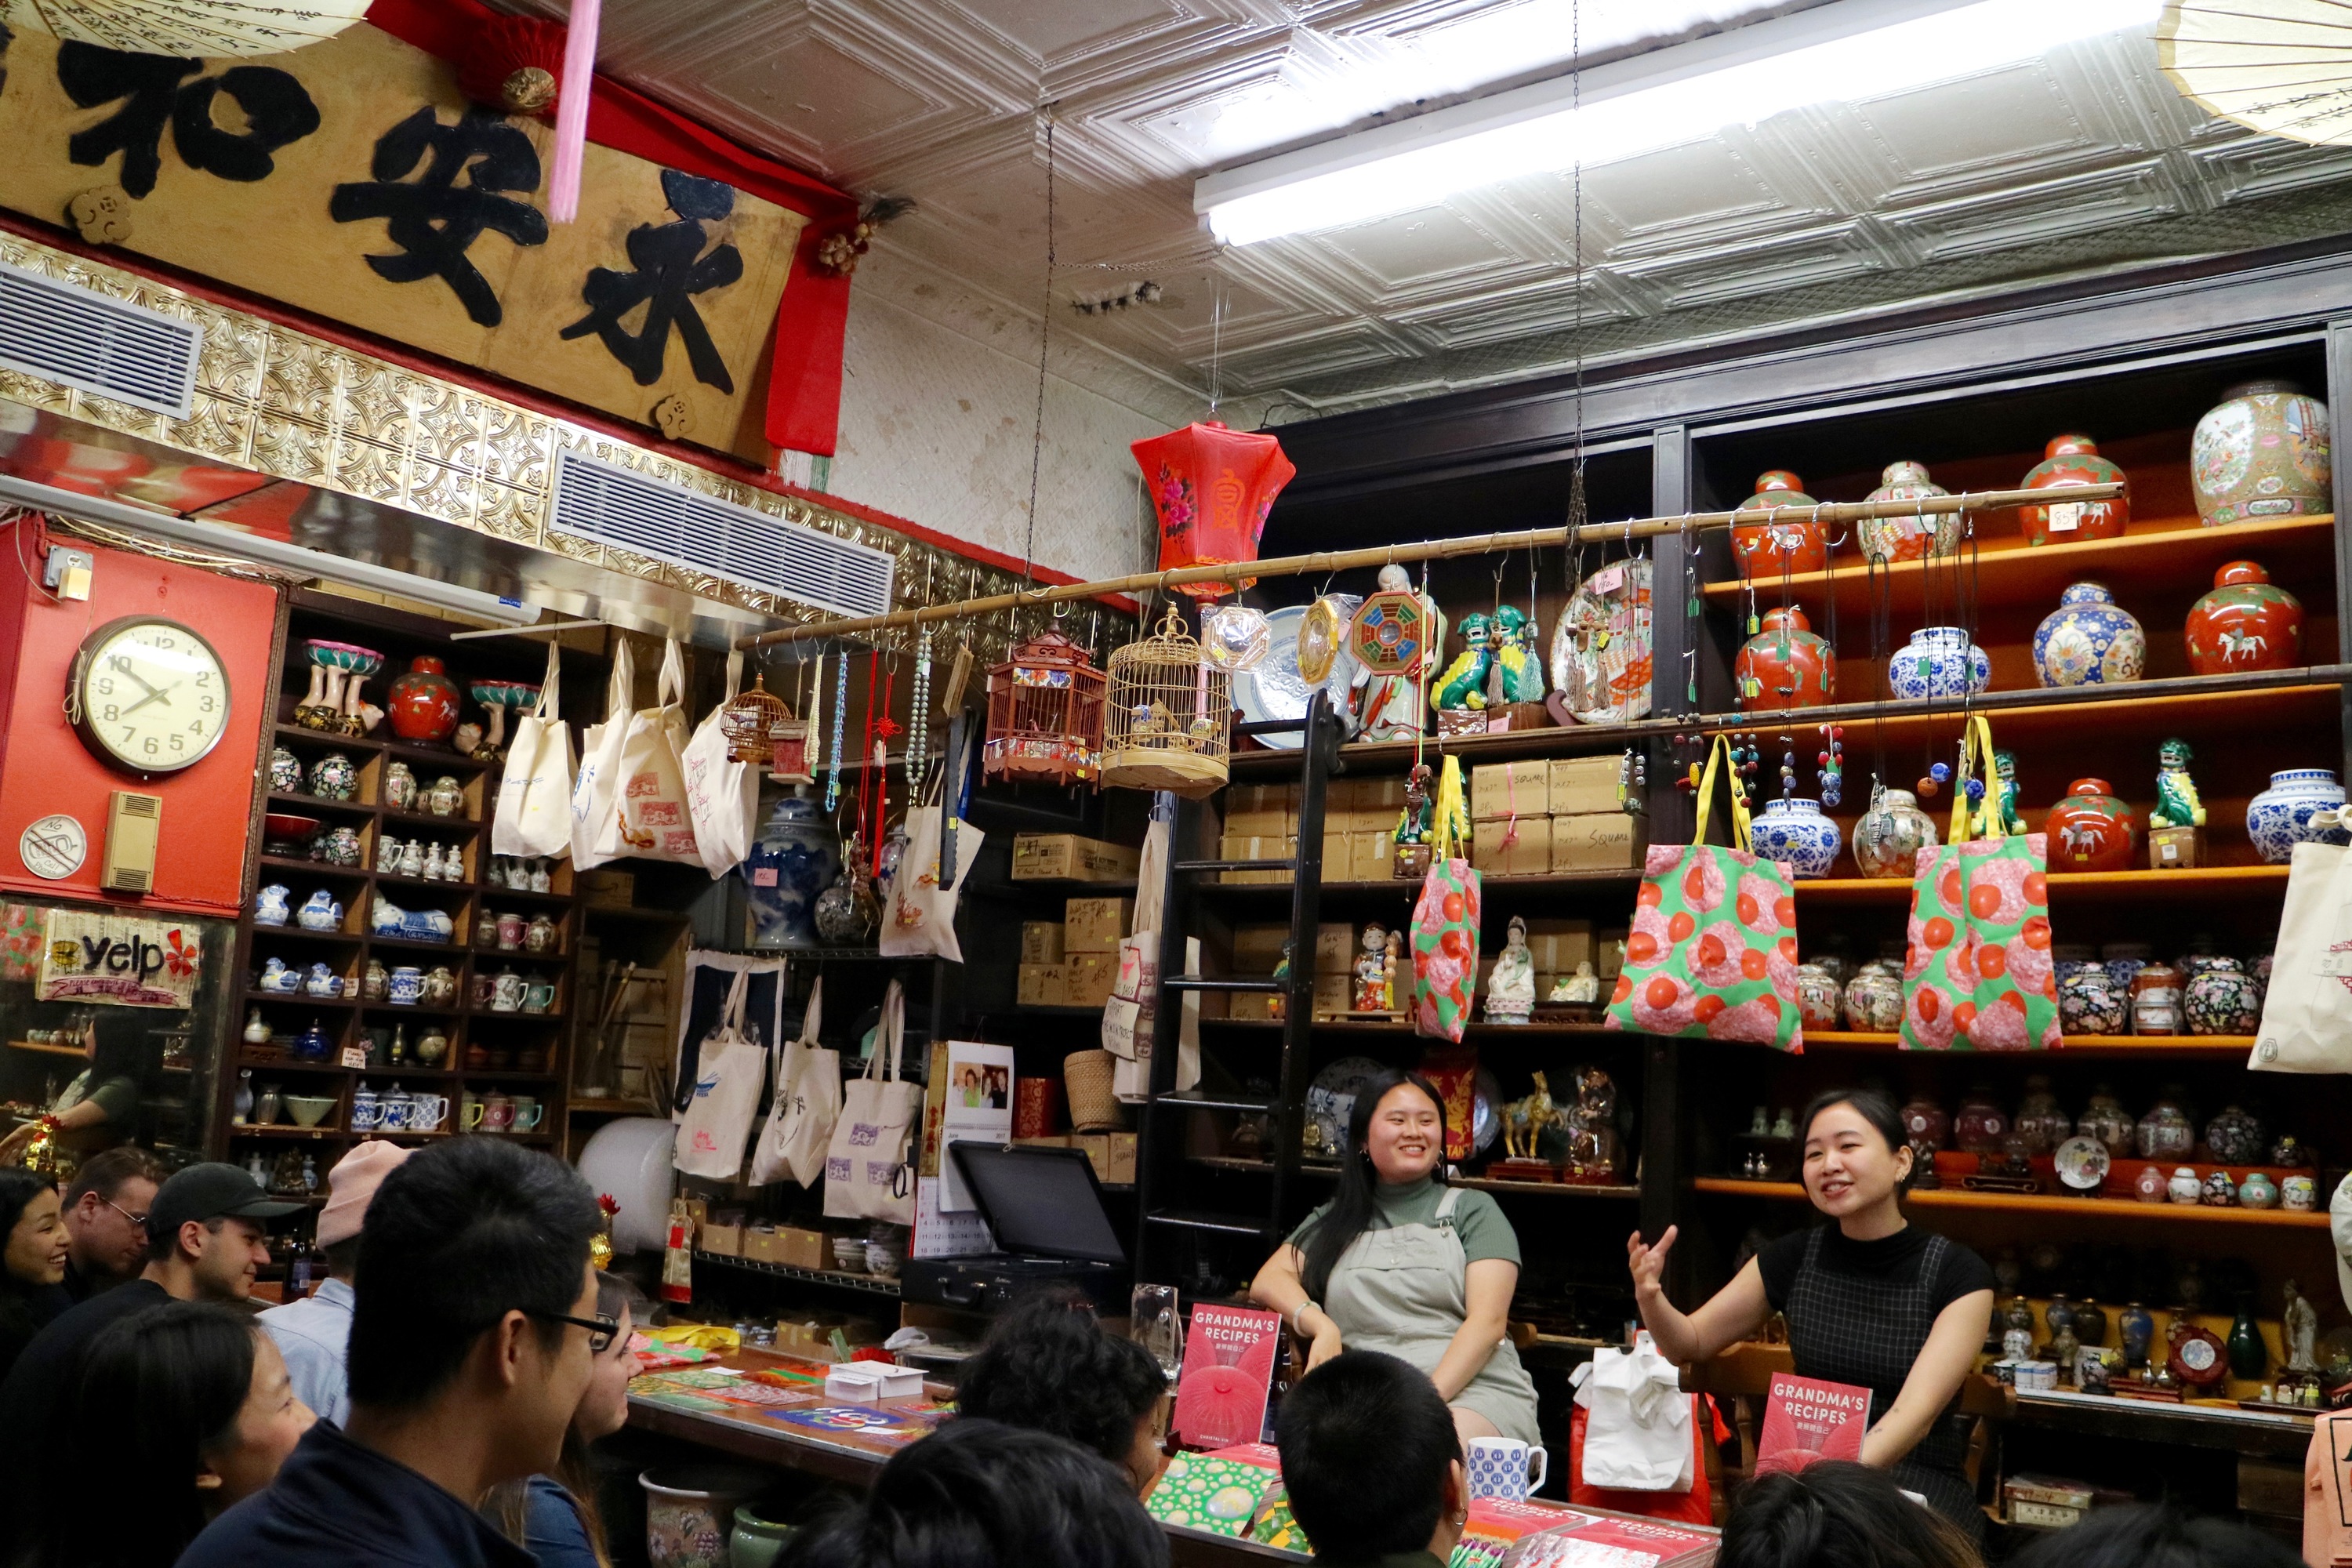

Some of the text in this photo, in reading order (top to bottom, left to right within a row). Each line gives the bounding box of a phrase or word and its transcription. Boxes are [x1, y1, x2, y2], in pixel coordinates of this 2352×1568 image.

[0, 27, 741, 396] 永安和
[499, 597, 521, 606] DA-LITE
[108, 654, 132, 673] 10
[98, 677, 114, 695] 9
[195, 671, 210, 688] 2
[199, 695, 214, 712] 3
[103, 704, 119, 721] 8
[122, 725, 136, 742] 7
[188, 720, 204, 735] 4
[143, 737, 159, 754] 6
[169, 733, 184, 751] 5
[1515, 775, 1545, 784] SQUARE
[1588, 829, 1629, 849] SQUARE
[82, 934, 165, 983] yelp
[1195, 1312, 1275, 1332] GRANDMA'S
[1205, 1327, 1260, 1344] RECIPES
[1773, 1383, 1864, 1410] GRANDMA'S
[1785, 1402, 1847, 1425] RECIPES
[1484, 1497, 1580, 1520] GRANDMA'S
[1492, 1502, 1557, 1519] RECIPES
[1608, 1519, 1711, 1542] GRANDMA'S
[1617, 1524, 1689, 1541] RECIPES
